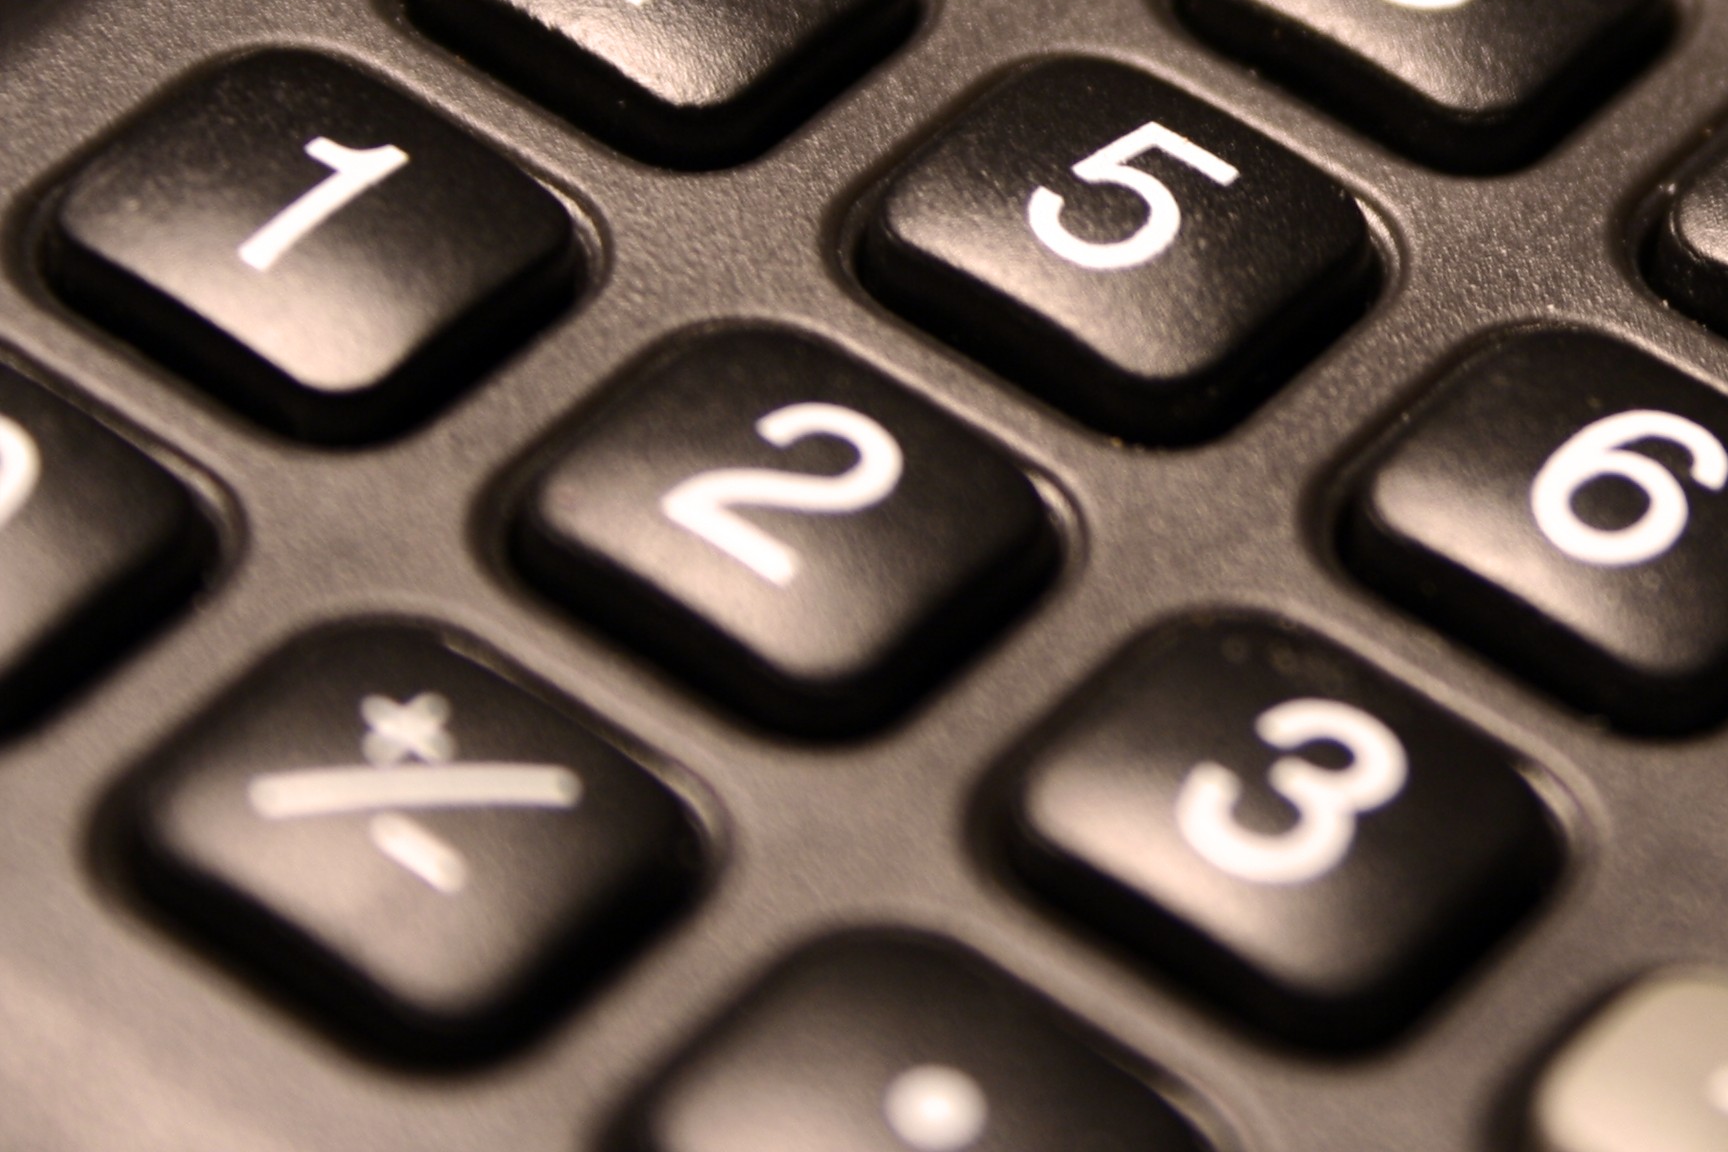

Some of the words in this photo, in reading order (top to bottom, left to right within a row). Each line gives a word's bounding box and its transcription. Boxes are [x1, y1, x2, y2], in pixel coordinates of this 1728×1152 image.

[237, 135, 409, 272] 1
[1028, 121, 1239, 270] 5
[661, 401, 903, 587] 2
[1177, 697, 1406, 884] 3
